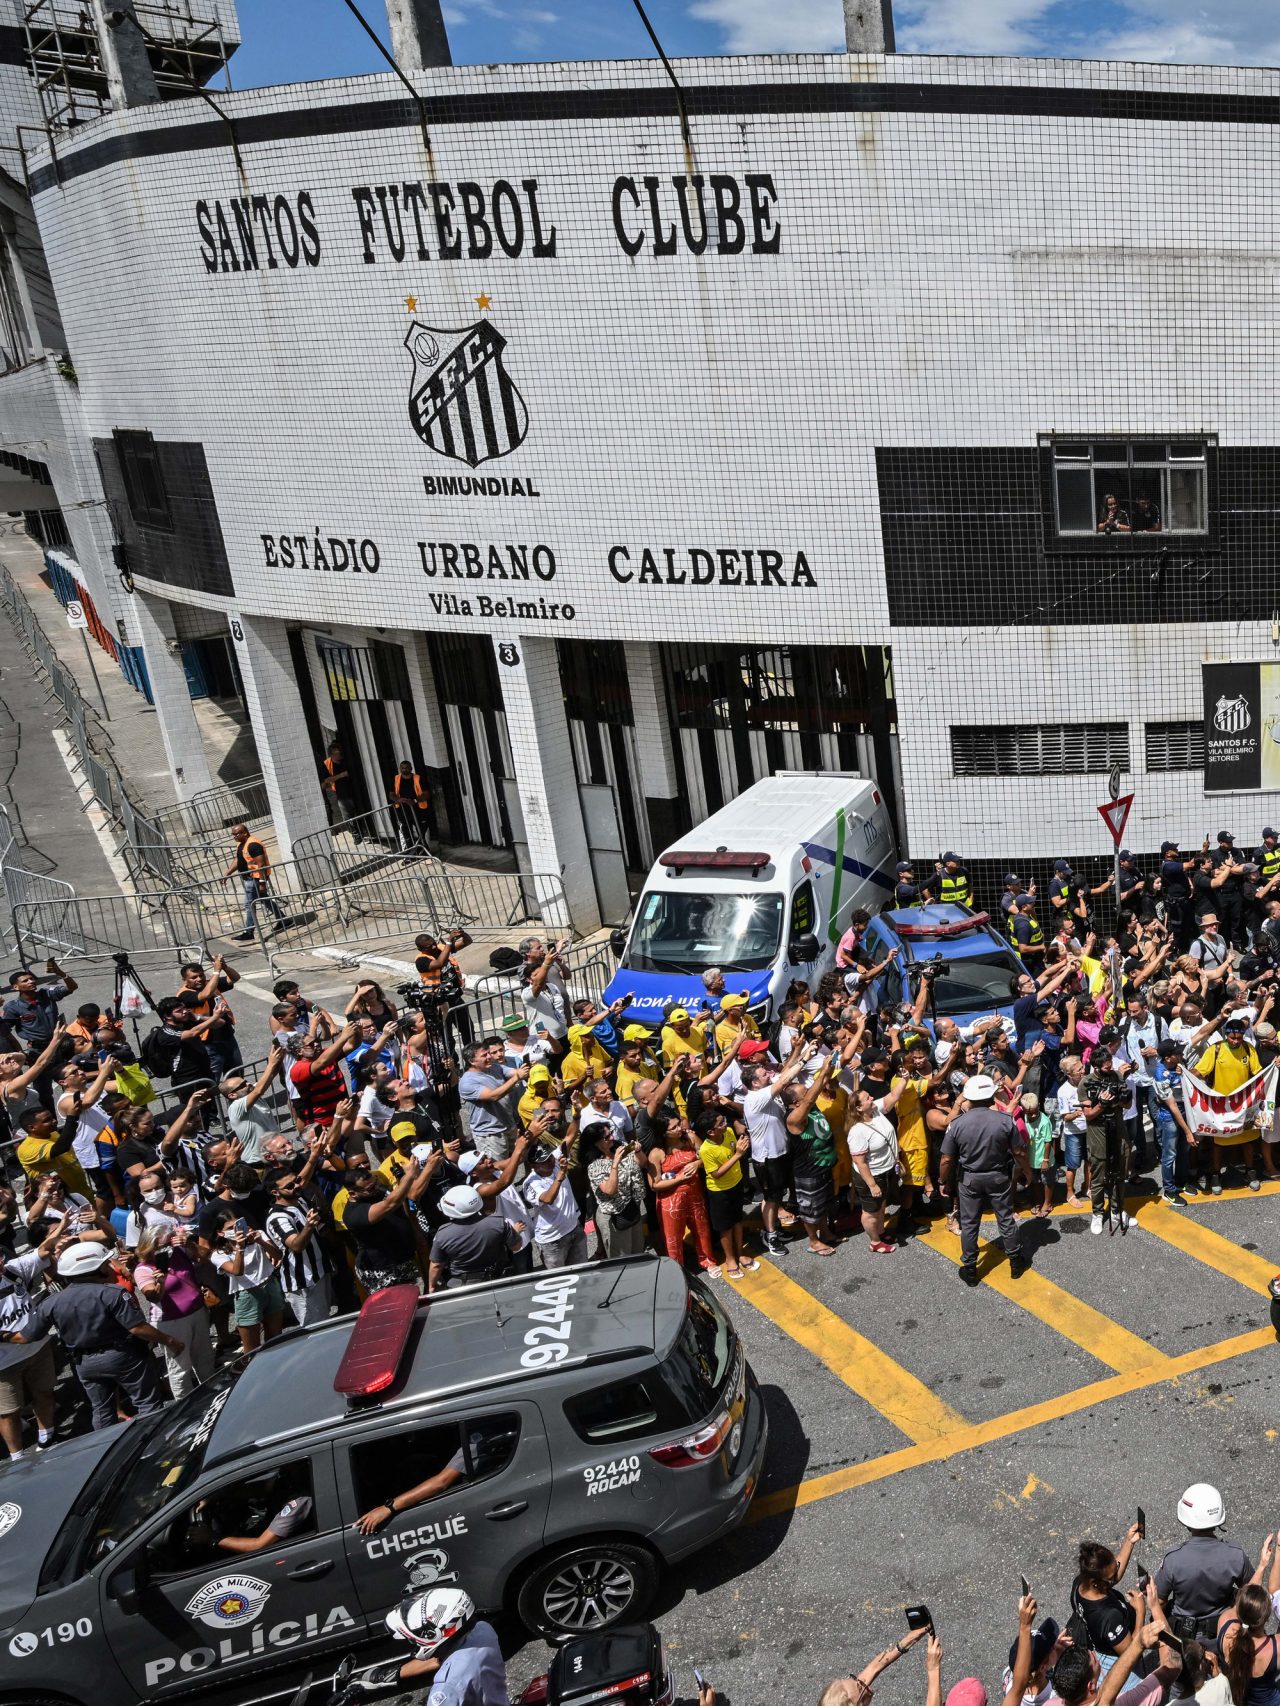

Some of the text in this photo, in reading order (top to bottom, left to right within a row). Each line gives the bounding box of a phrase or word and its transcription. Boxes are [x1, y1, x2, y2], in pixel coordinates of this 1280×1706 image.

[196, 174, 781, 274] SANTOS FUTEBOL CLUBE
[416, 333, 494, 428] S.F.C.
[423, 476, 540, 497] BIMUNDIAL
[260, 526, 818, 587] ESTÁDIO URBANO CALDEIRA
[428, 593, 576, 621] Vila Belmiro
[504, 648, 514, 662] 3
[1208, 738, 1258, 748] SANTOS F.C.
[1223, 746, 1254, 755] BELMIRO
[1208, 754, 1240, 763] SETORES
[1197, 1123, 1219, 1135] São
[520, 1274, 580, 1368] 92440
[583, 1455, 640, 1483] 92440
[586, 1469, 641, 1497] ROCAM
[366, 1515, 469, 1560] CHOQUE
[192, 1578, 264, 1610] POLÍCIA MILITAR
[40, 1617, 93, 1647] 190
[145, 1605, 356, 1687] POLÍCIA
